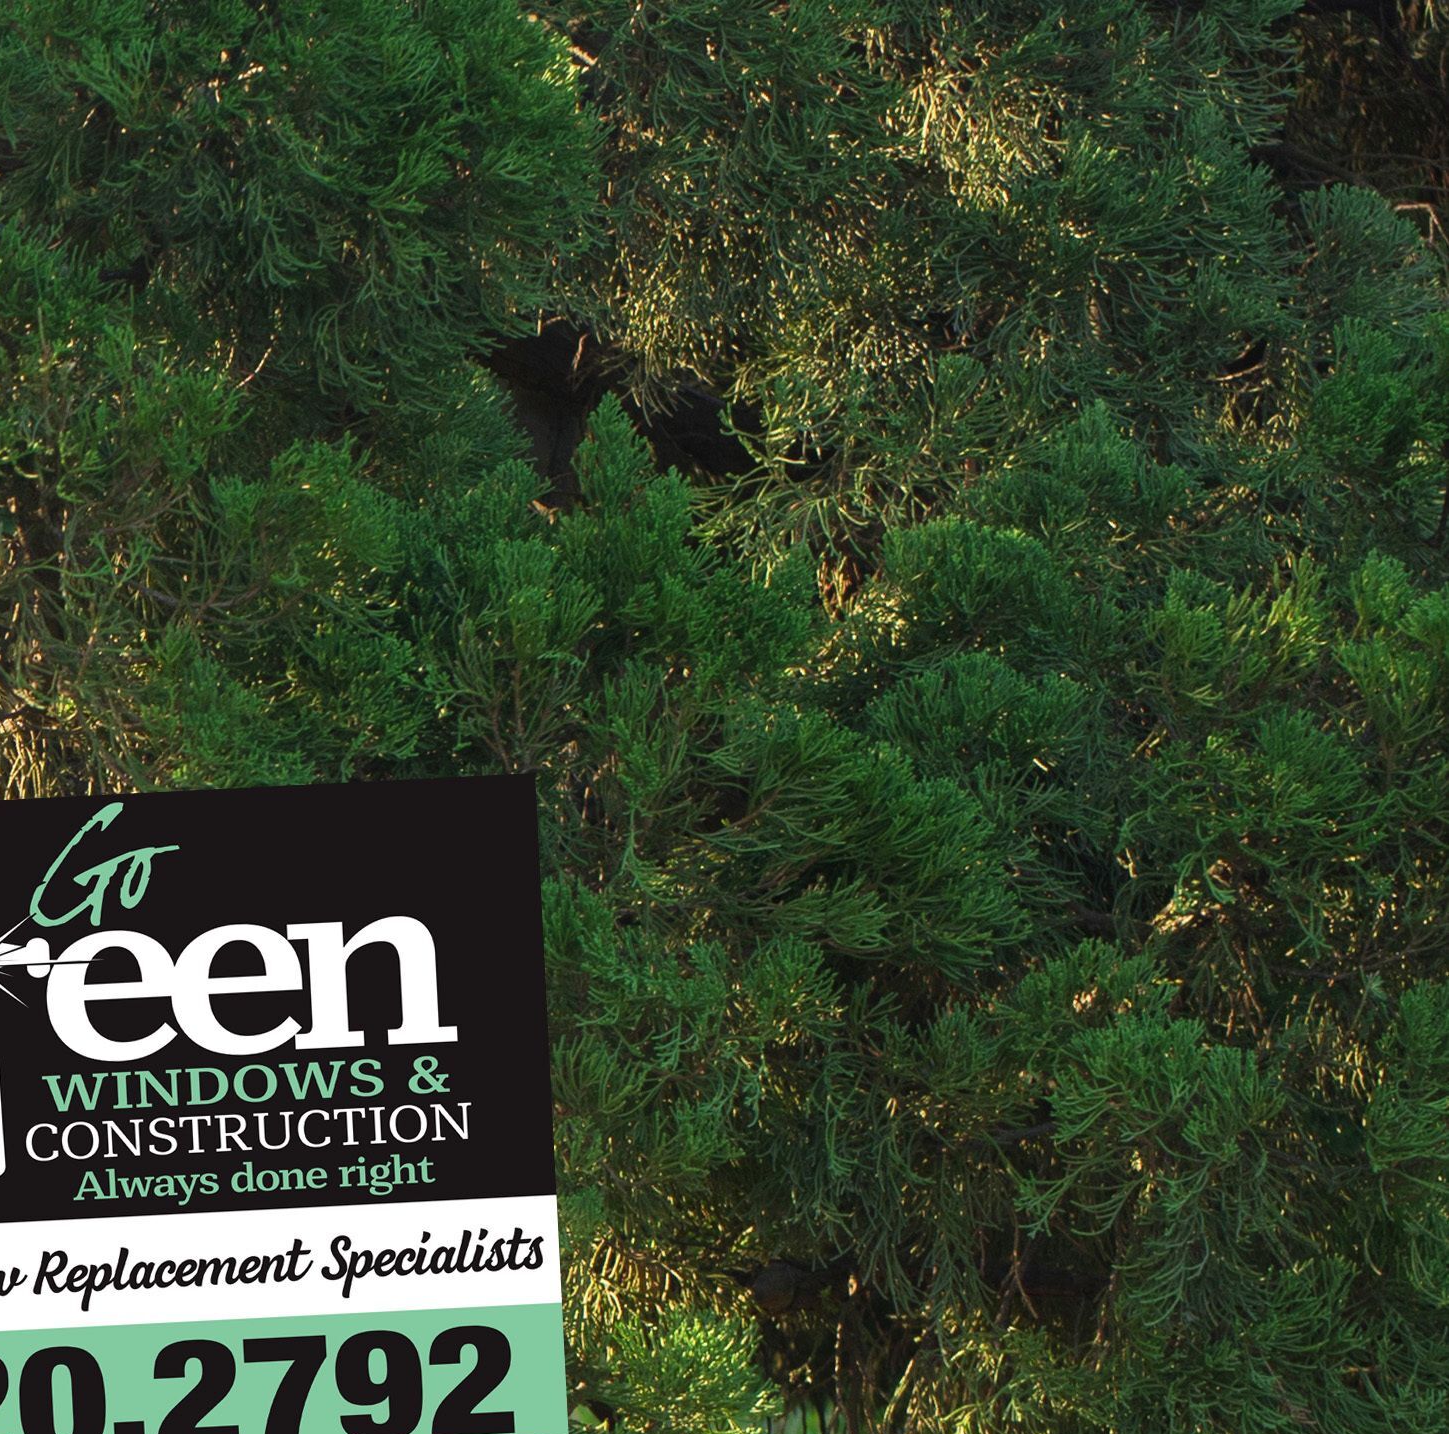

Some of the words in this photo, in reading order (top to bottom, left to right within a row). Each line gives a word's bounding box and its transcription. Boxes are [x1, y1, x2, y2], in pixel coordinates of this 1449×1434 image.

[29, 802, 180, 928] Go
[41, 1059, 385, 1112] WINDOWS
[408, 1055, 450, 1095] &
[25, 1102, 472, 1162] CONSTRUCTION
[73, 1168, 220, 1206] Always
[230, 1161, 328, 1193] done
[339, 1153, 436, 1196] right
[32, 1238, 314, 1312] Replacement
[321, 1227, 545, 1299] Specialists
